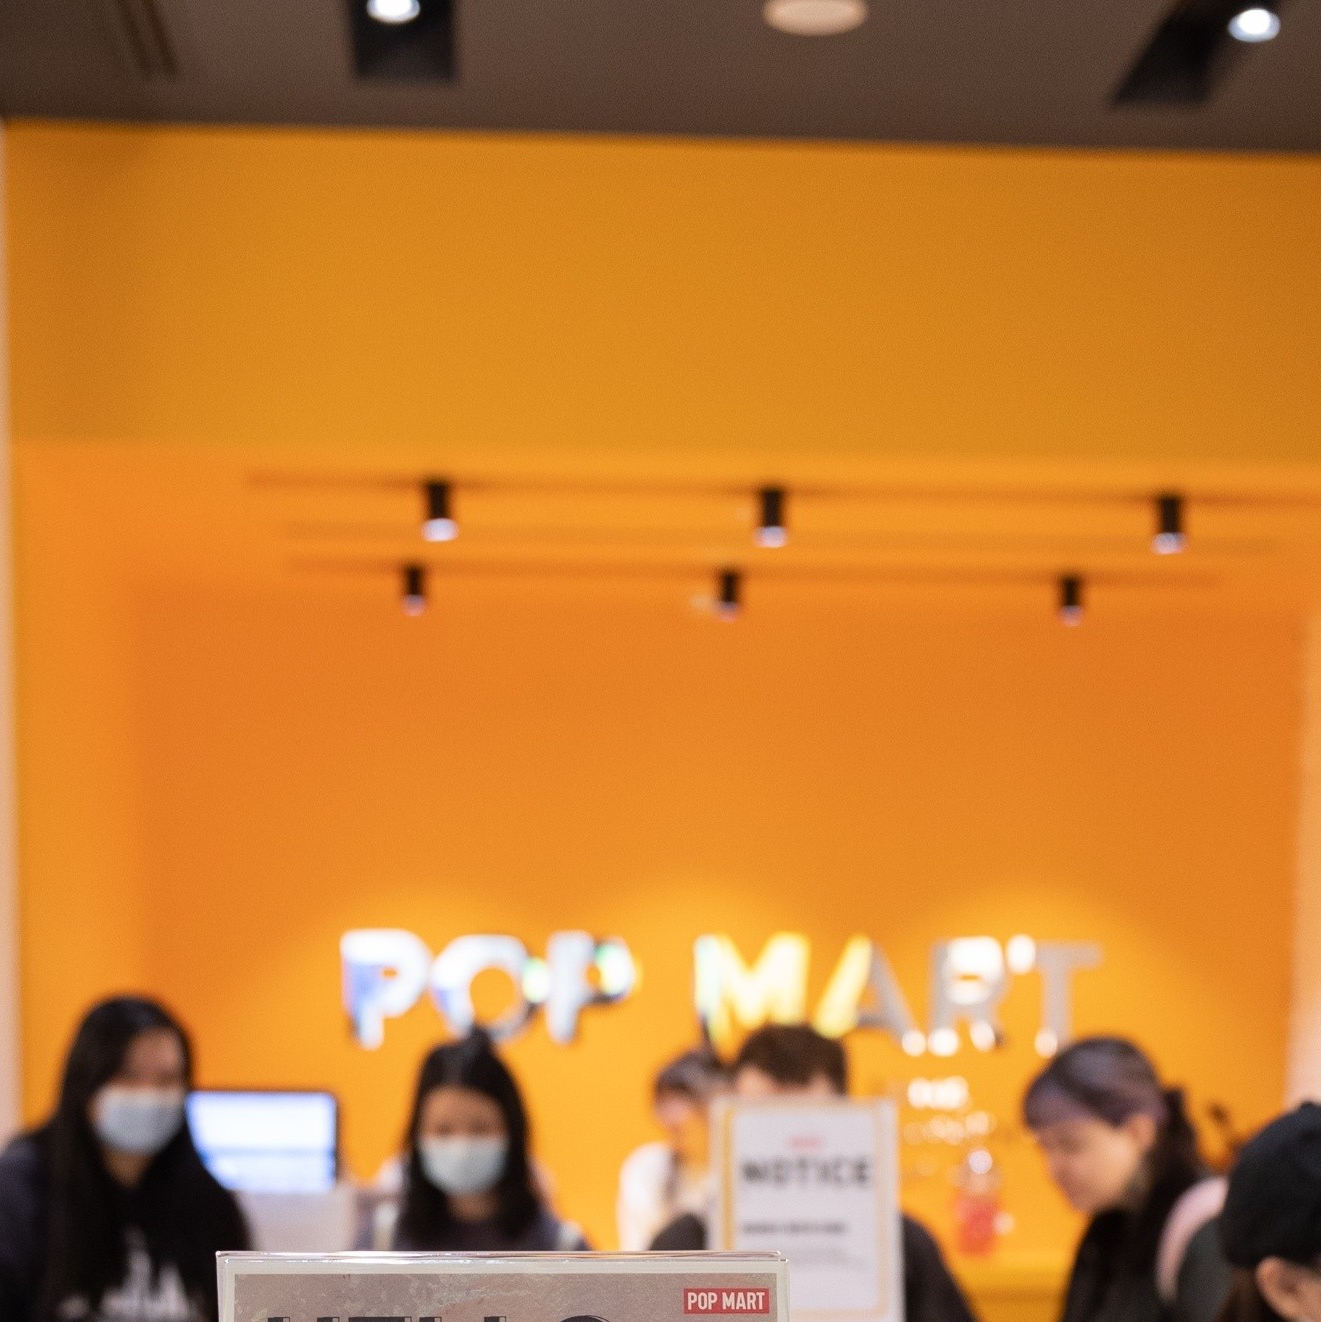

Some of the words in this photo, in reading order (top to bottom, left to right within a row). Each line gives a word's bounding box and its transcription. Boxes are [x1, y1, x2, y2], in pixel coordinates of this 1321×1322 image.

[338, 927, 641, 1050] POP
[692, 931, 1104, 1058] MART
[741, 1153, 870, 1187] NOTICE
[687, 1291, 718, 1311] POP
[722, 1291, 765, 1311] MART
